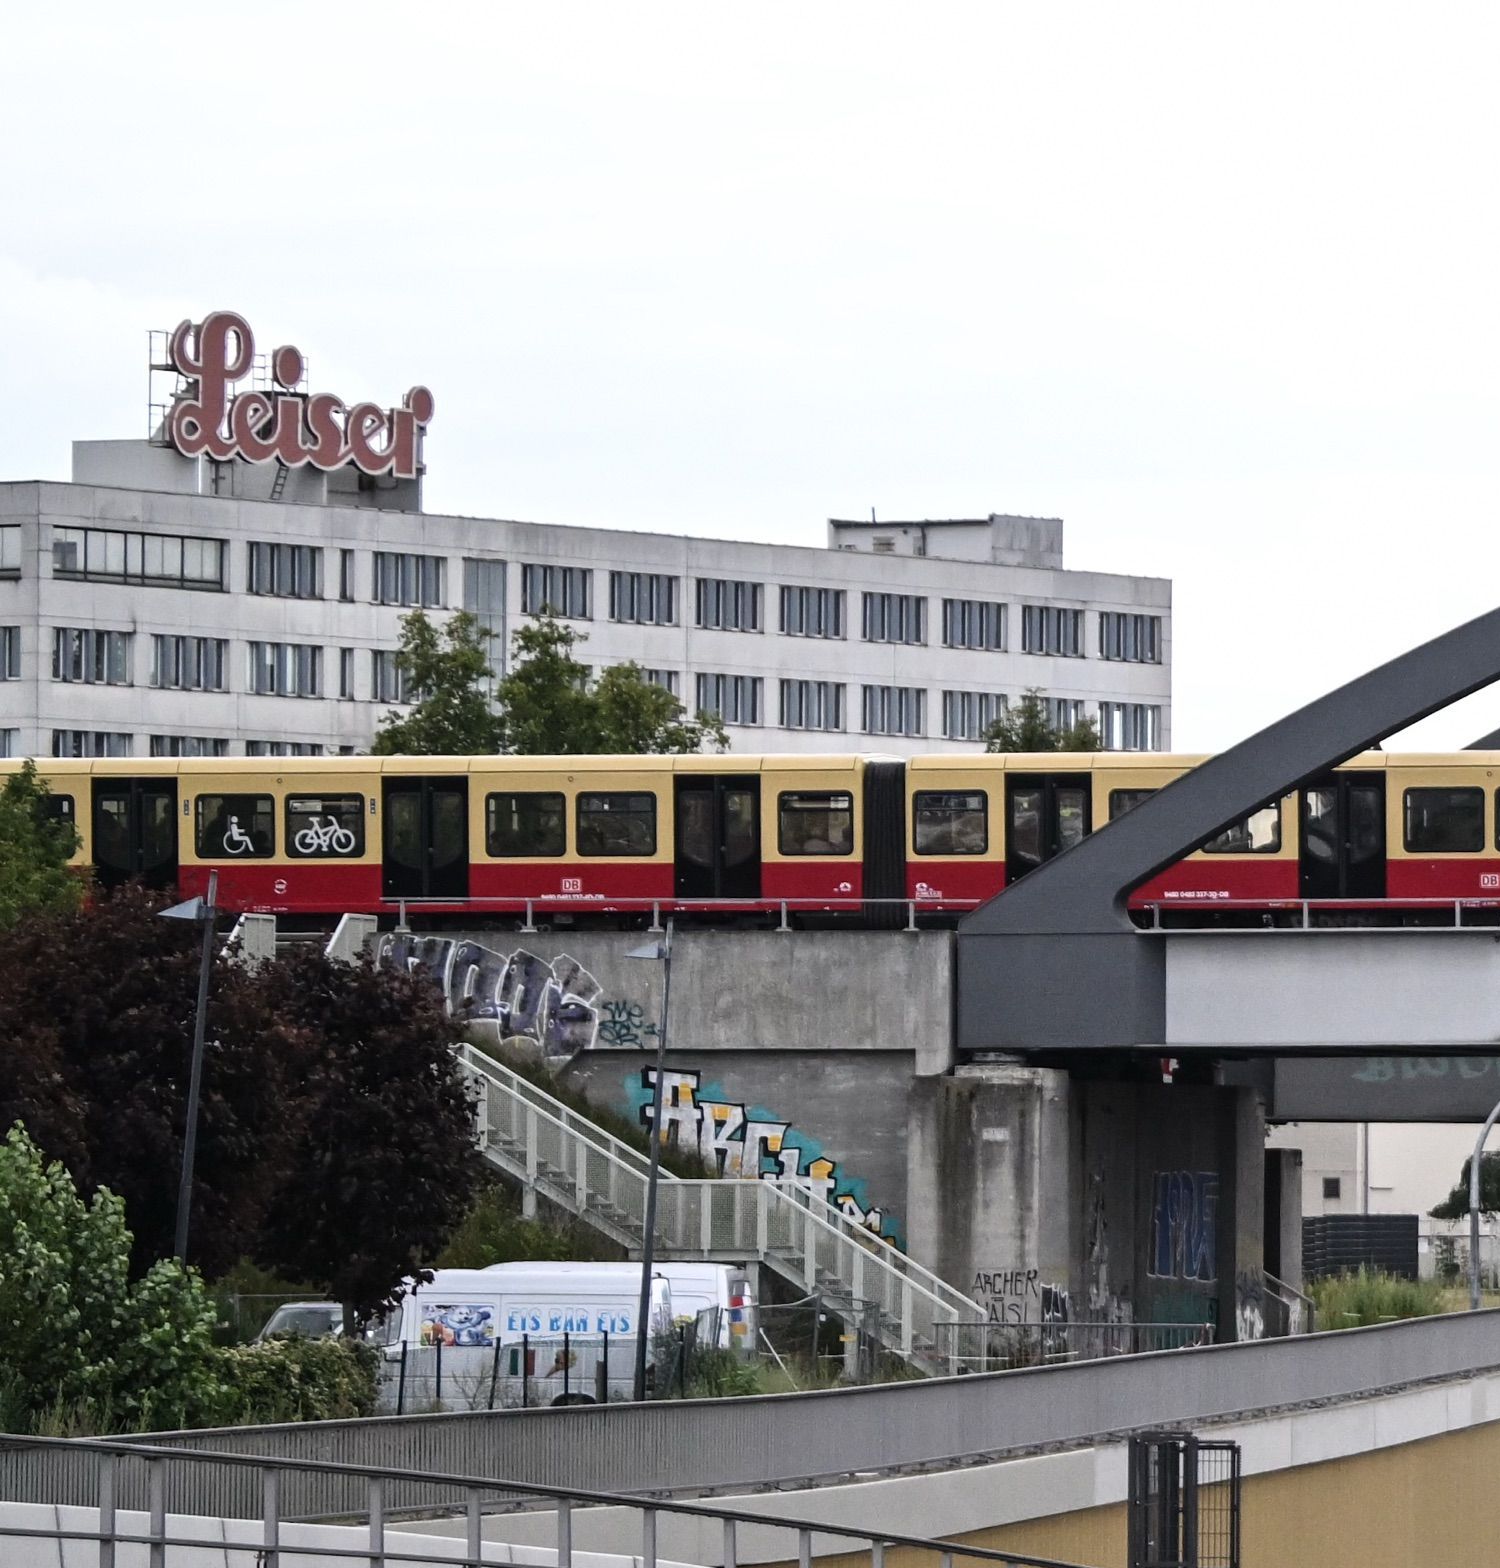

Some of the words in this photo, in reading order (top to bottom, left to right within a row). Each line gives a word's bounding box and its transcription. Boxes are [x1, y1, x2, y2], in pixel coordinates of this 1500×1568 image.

[171, 310, 435, 479] Leiser
[562, 878, 581, 891] DB
[1481, 874, 1499, 887] DB
[971, 1268, 1038, 1298] ARCHER
[507, 1307, 541, 1331] EIS
